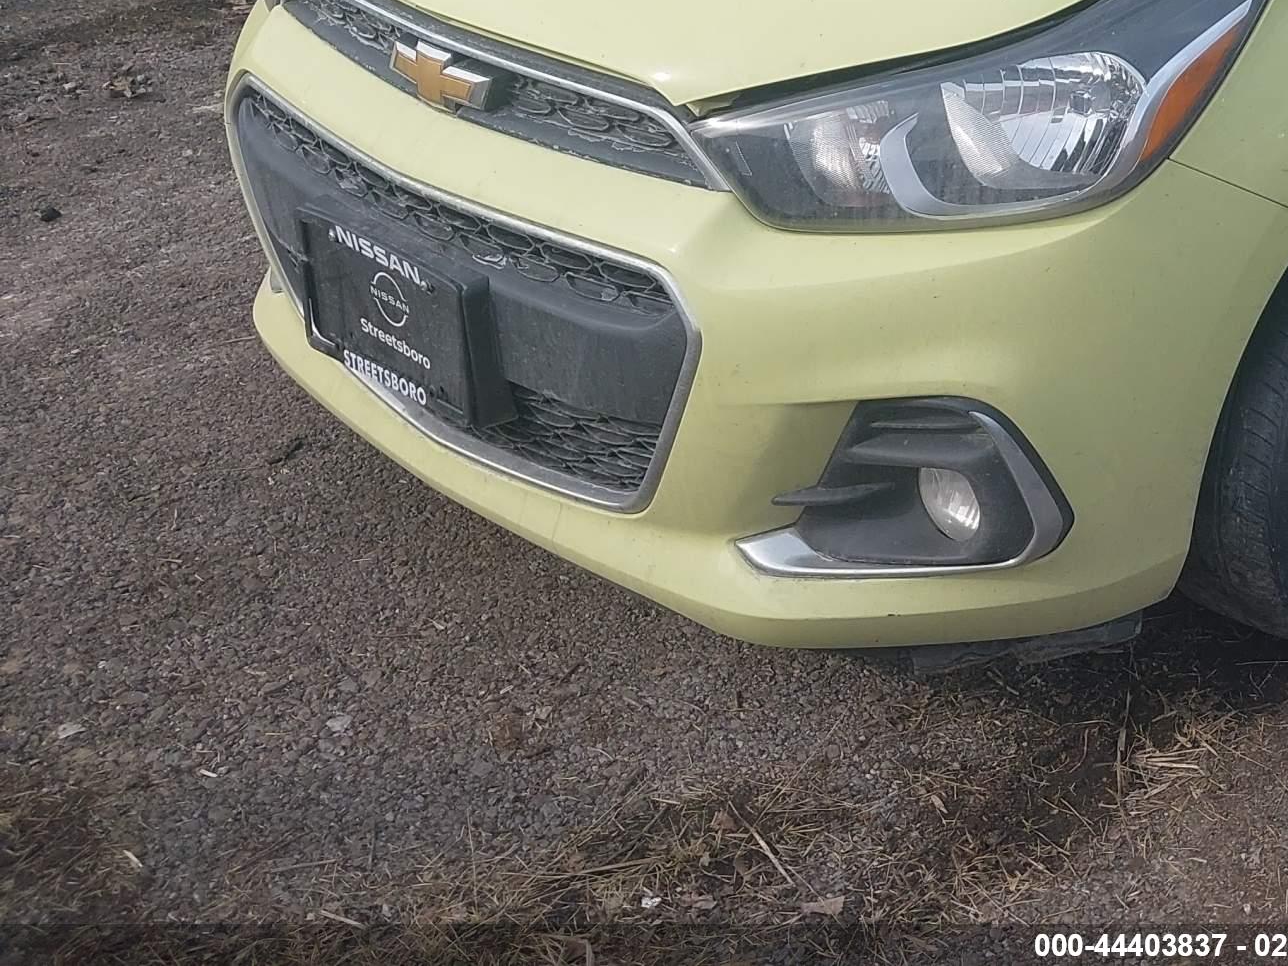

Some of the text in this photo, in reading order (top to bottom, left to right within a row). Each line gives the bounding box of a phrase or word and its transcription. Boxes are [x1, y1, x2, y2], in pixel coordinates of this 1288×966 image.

[335, 225, 421, 285] NISSAN
[370, 285, 410, 315] NISSAN
[360, 318, 431, 369] Streetsboro
[344, 350, 427, 405] STREETSBORO
